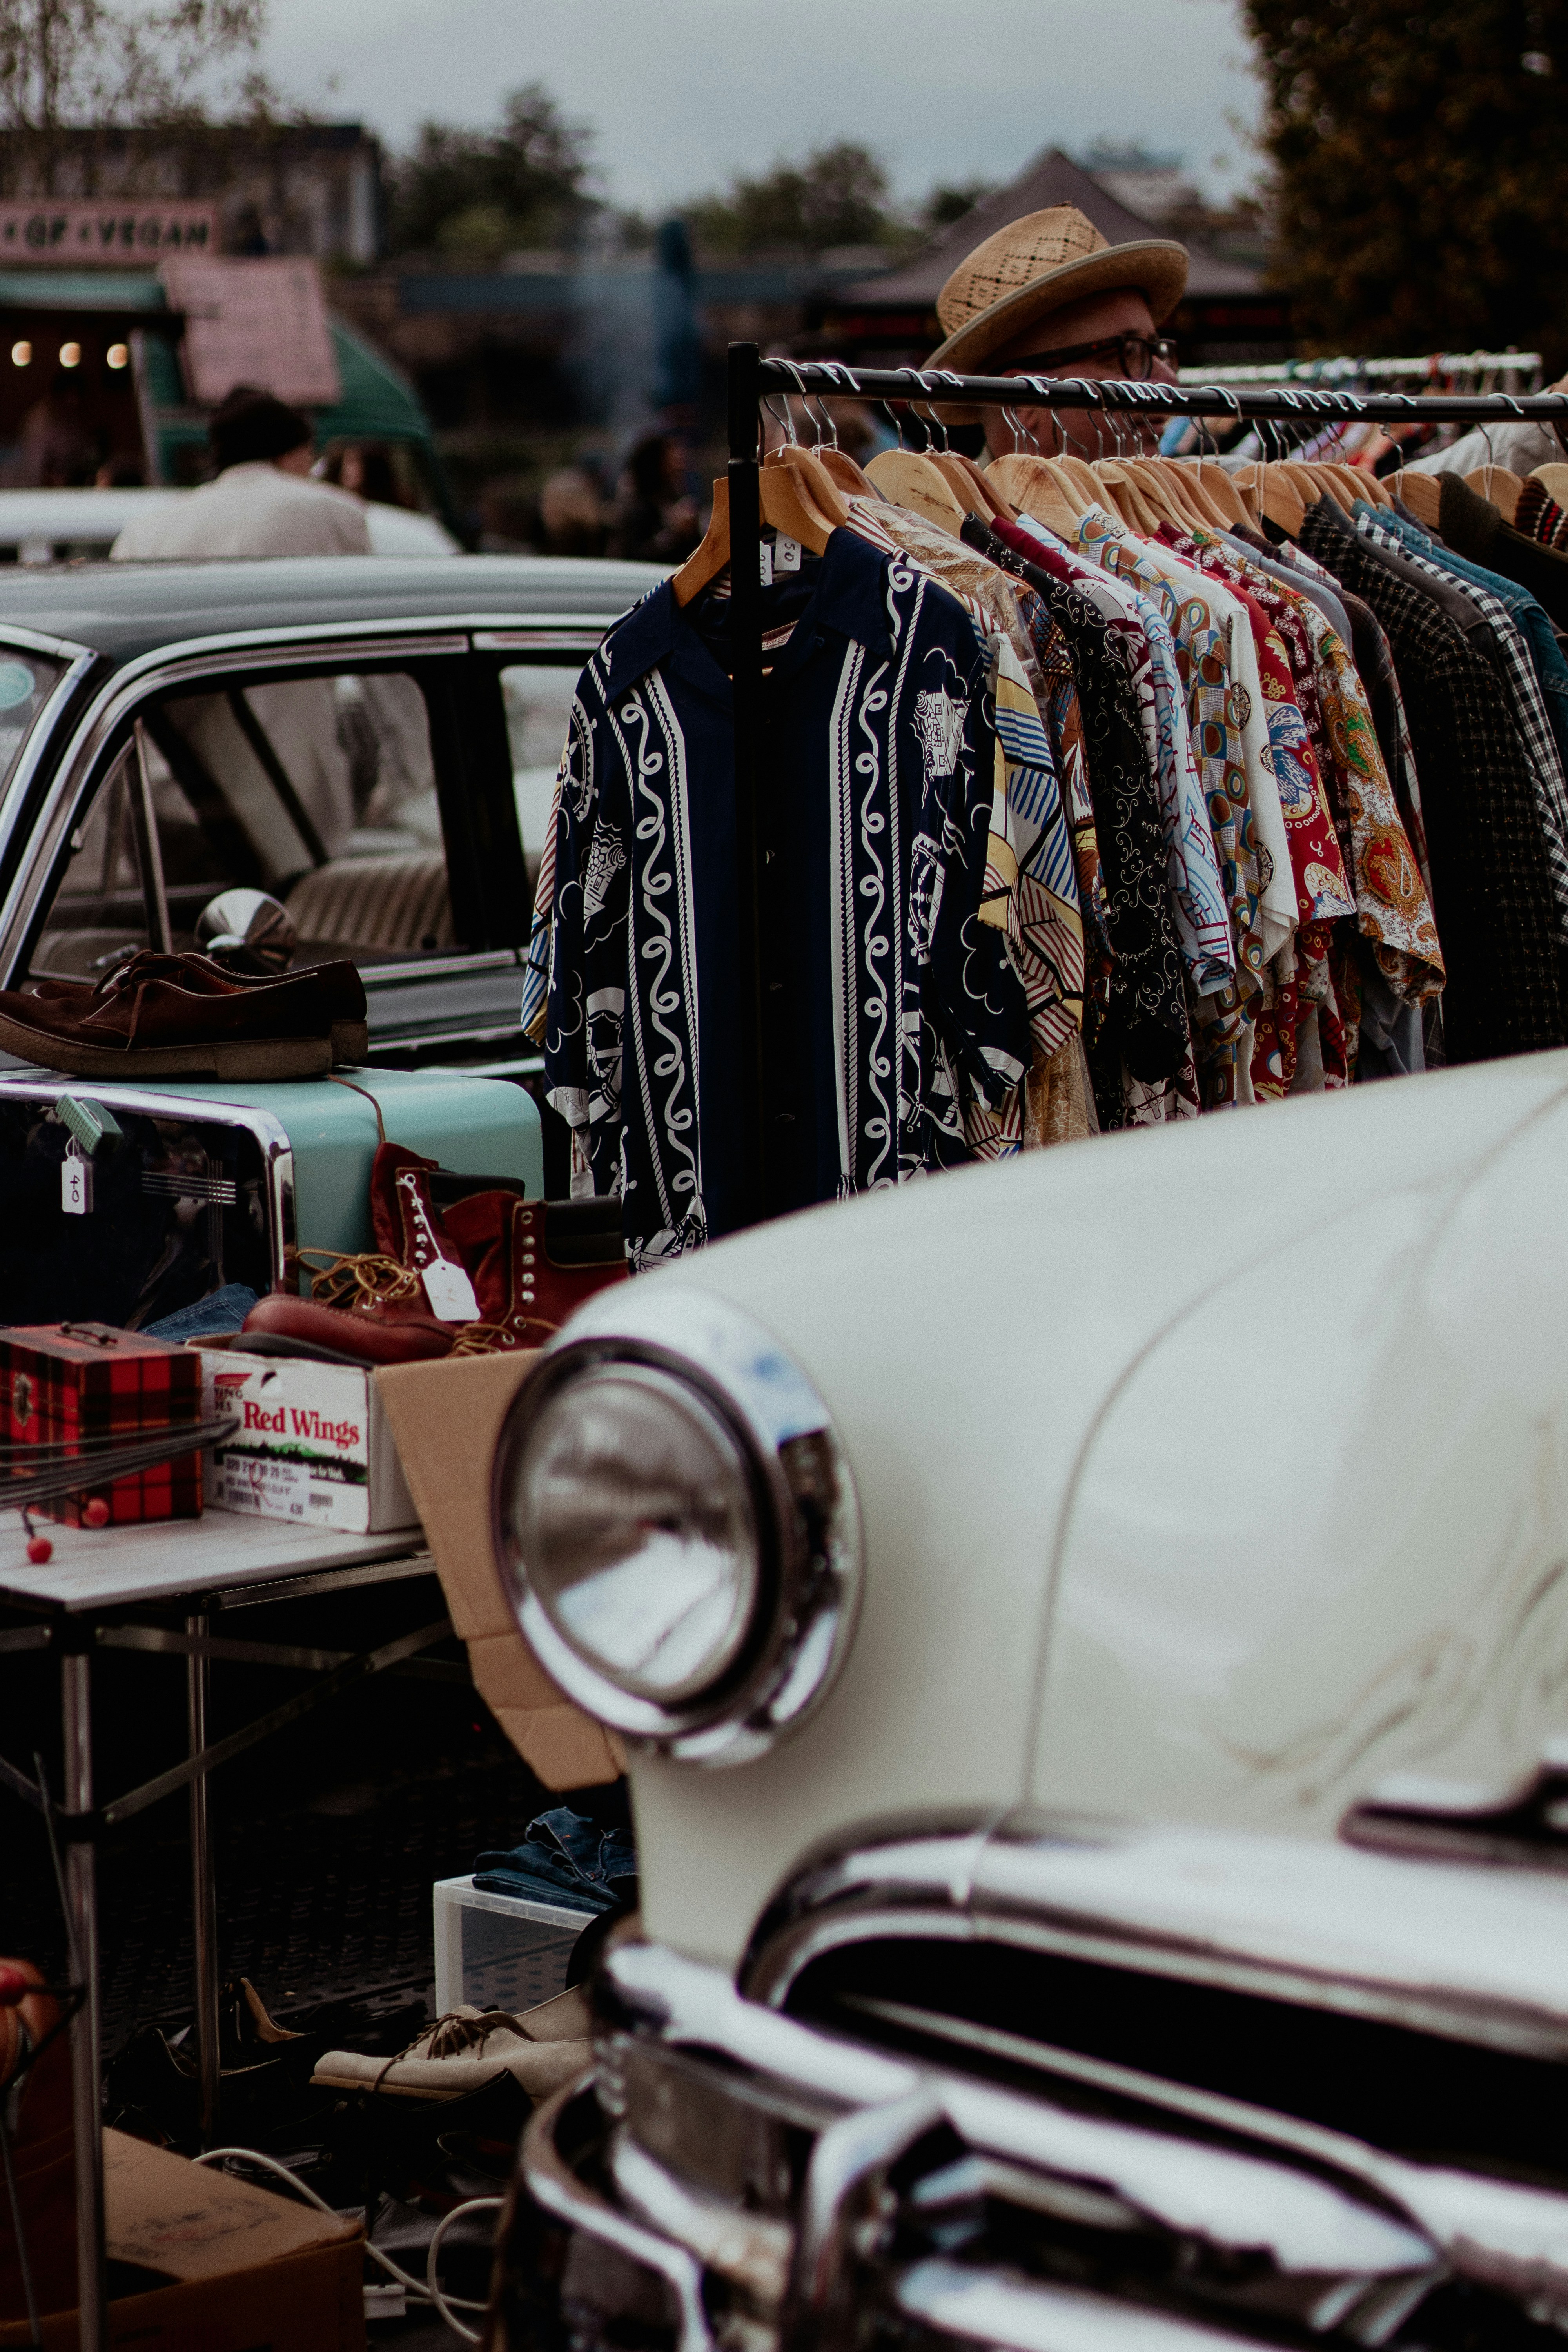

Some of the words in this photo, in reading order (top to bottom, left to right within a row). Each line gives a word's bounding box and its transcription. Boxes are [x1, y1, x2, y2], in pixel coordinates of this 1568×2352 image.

[99, 215, 209, 247] VEGAN
[784, 543, 795, 562] 50
[70, 1174, 80, 1202] 40
[243, 1401, 286, 1434] Red
[290, 1408, 360, 1450] Wings
